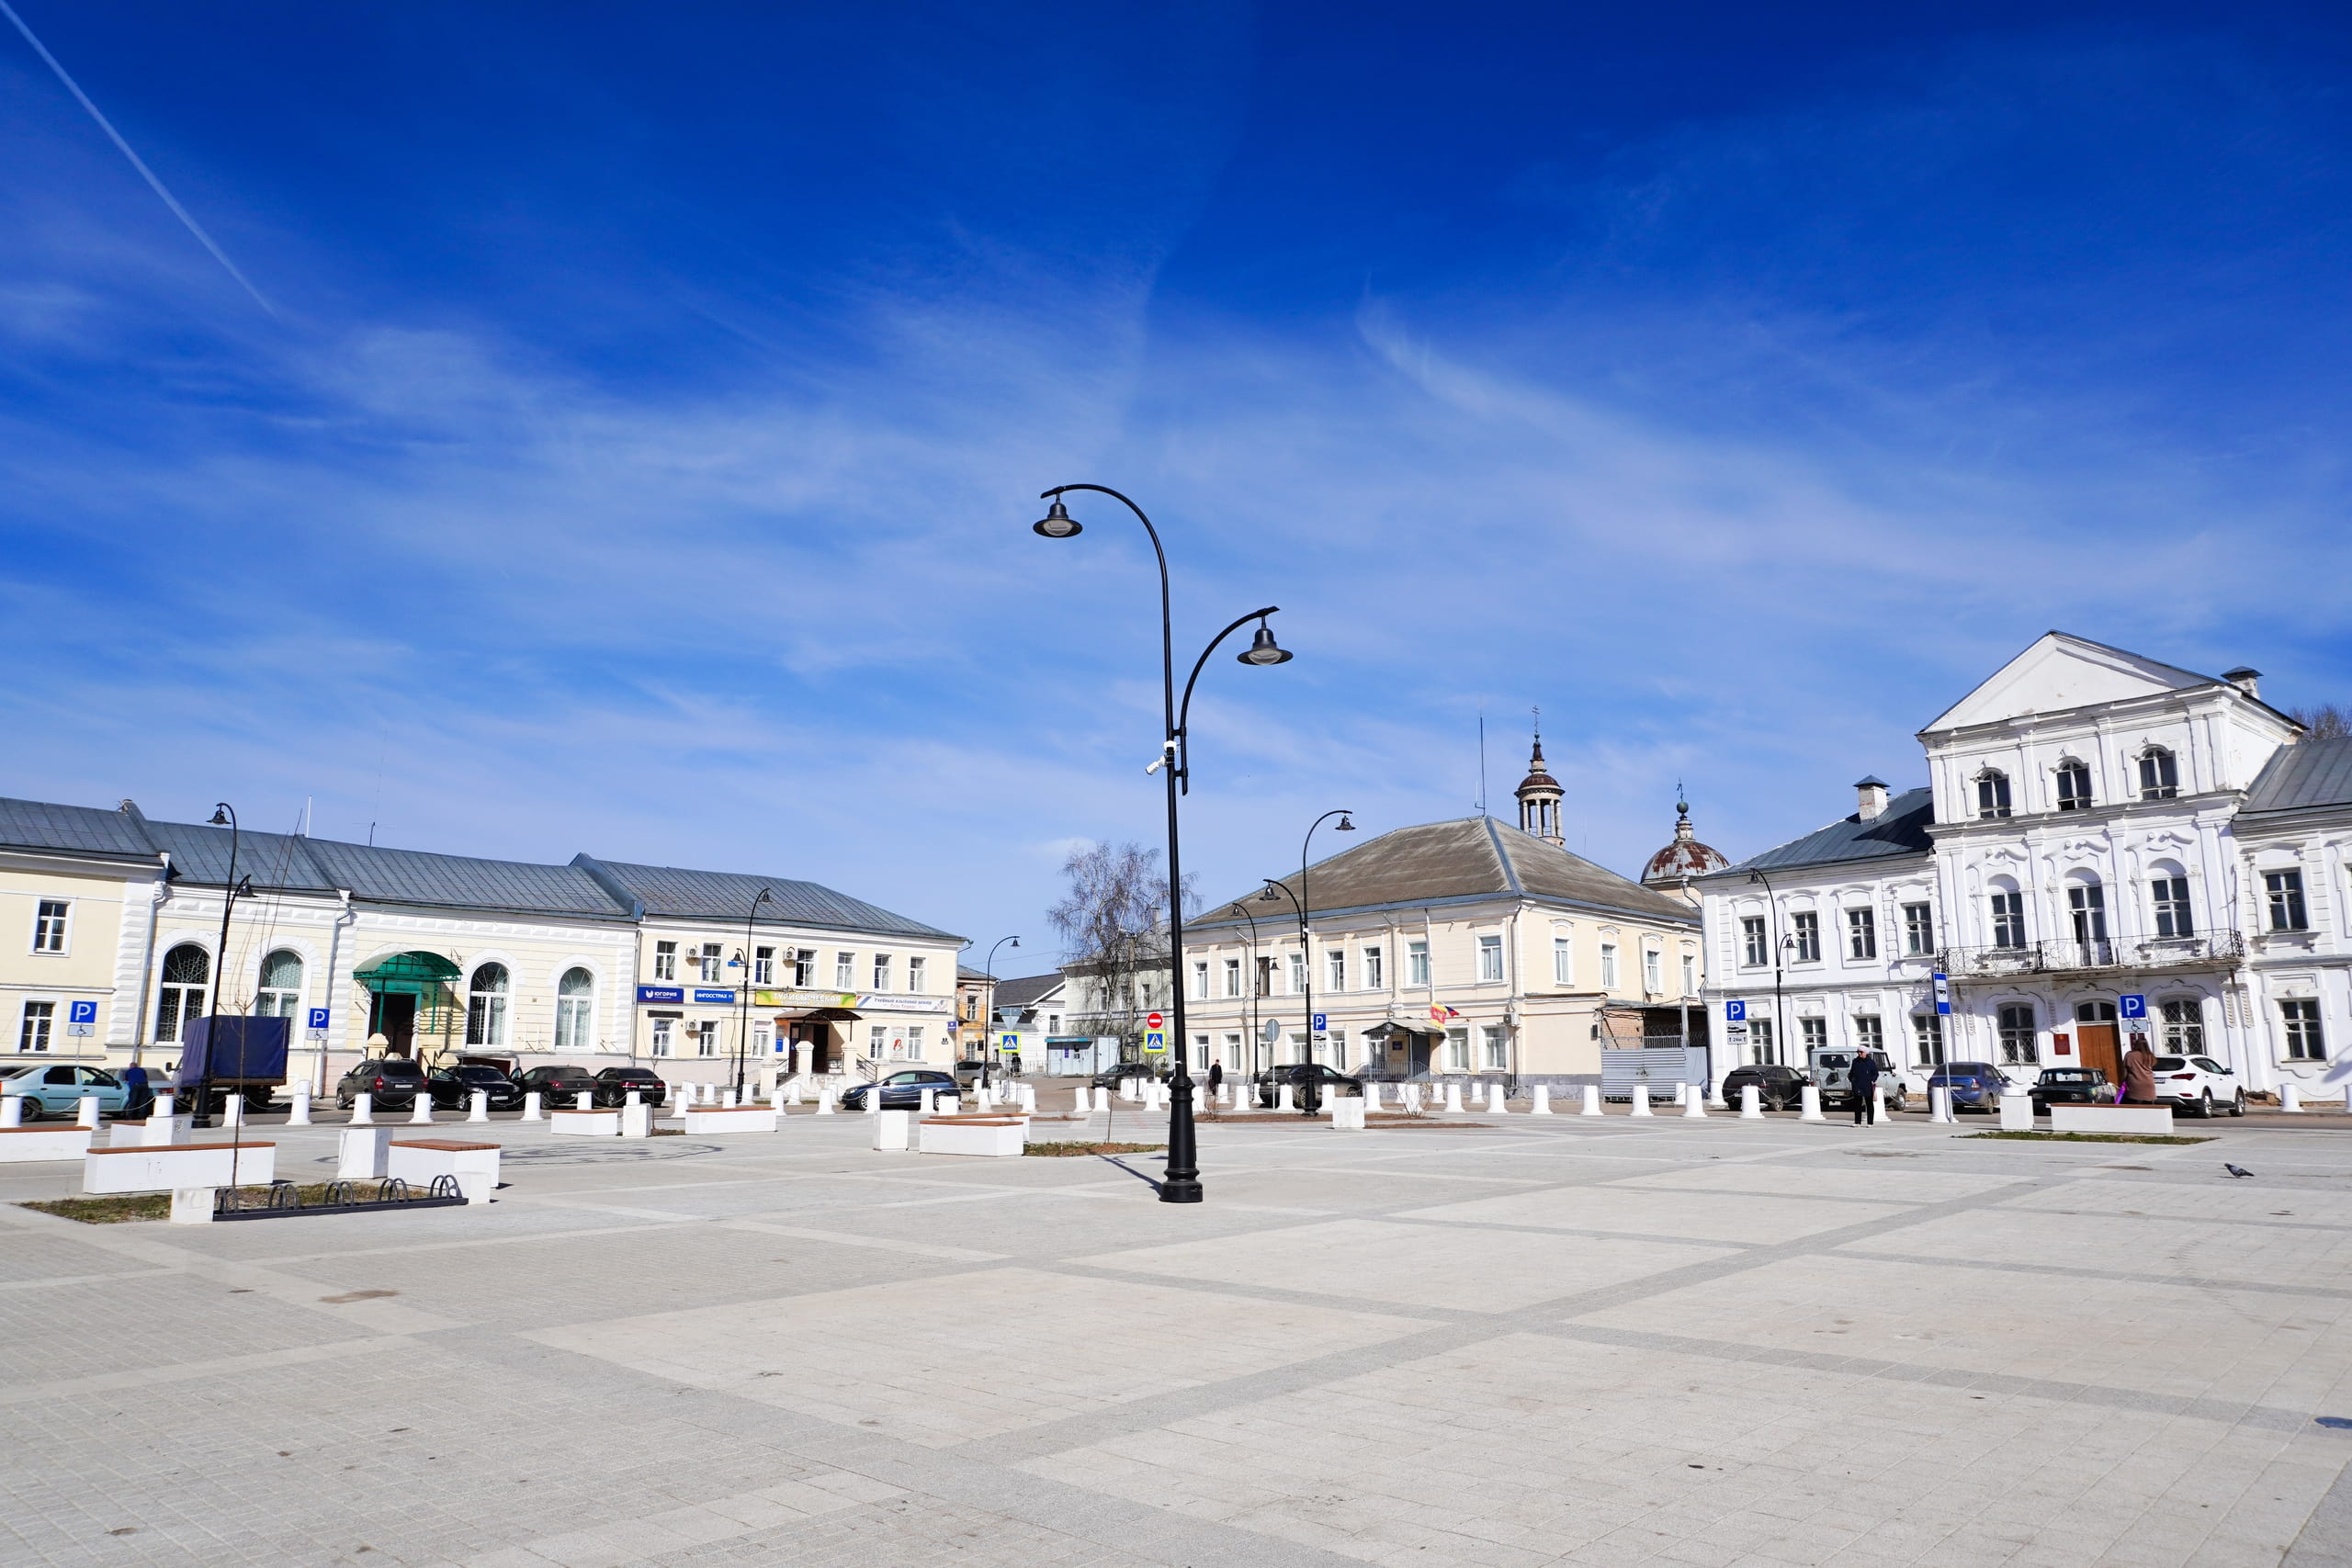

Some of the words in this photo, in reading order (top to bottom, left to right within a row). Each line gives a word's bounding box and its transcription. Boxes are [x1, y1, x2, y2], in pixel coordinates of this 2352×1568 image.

[774, 992, 841, 1003] ТУРИСТИЧЕСКАЯ
[75, 1003, 91, 1021] P
[1731, 1002, 1741, 1019] P
[2125, 998, 2140, 1016] P
[312, 1010, 325, 1026] P
[1316, 1015, 1324, 1030] P
